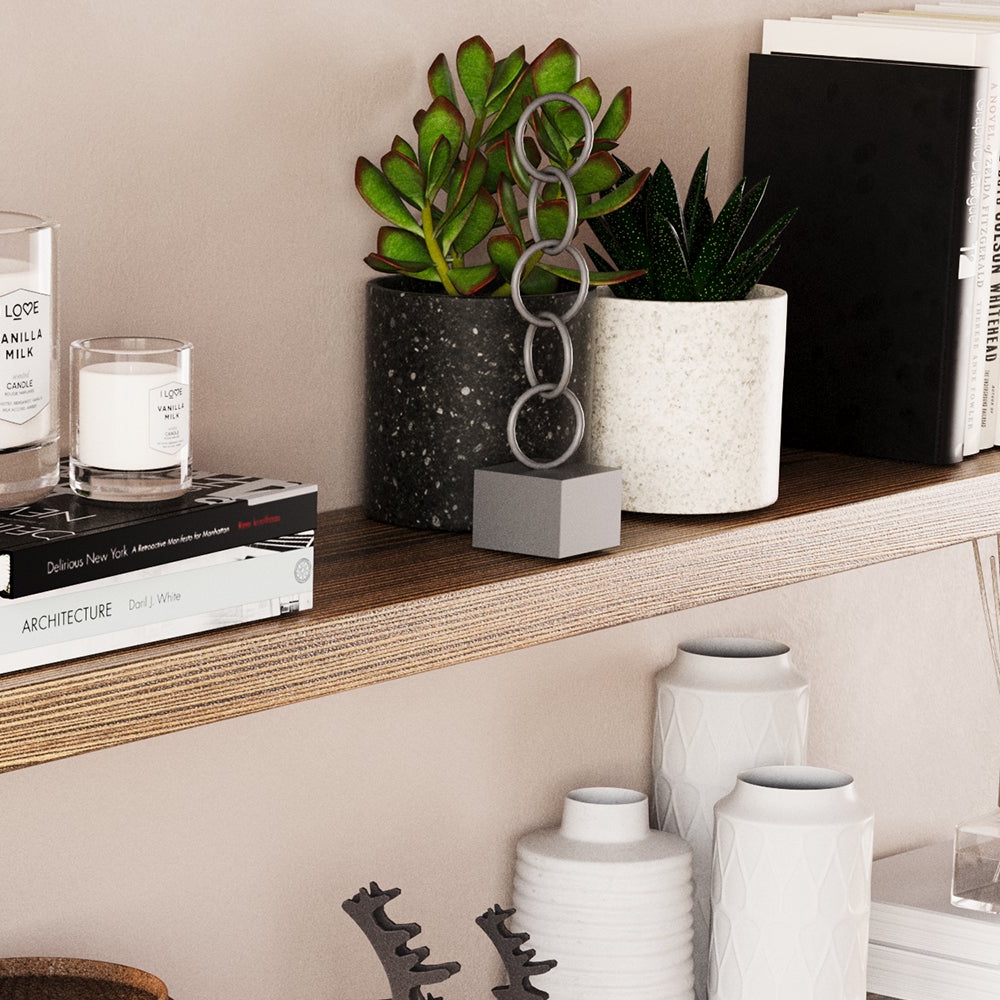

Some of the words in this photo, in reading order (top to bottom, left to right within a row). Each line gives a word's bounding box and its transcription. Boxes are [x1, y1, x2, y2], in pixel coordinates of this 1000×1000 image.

[985, 283, 1000, 362] WHITEHEAD
[6, 347, 33, 360] MILK
[7, 380, 33, 390] CANDLE
[48, 553, 83, 575] Delirious
[86, 550, 108, 565] New
[110, 545, 128, 559] York
[22, 602, 112, 633] ARCHITECTURE
[157, 591, 181, 604] White
